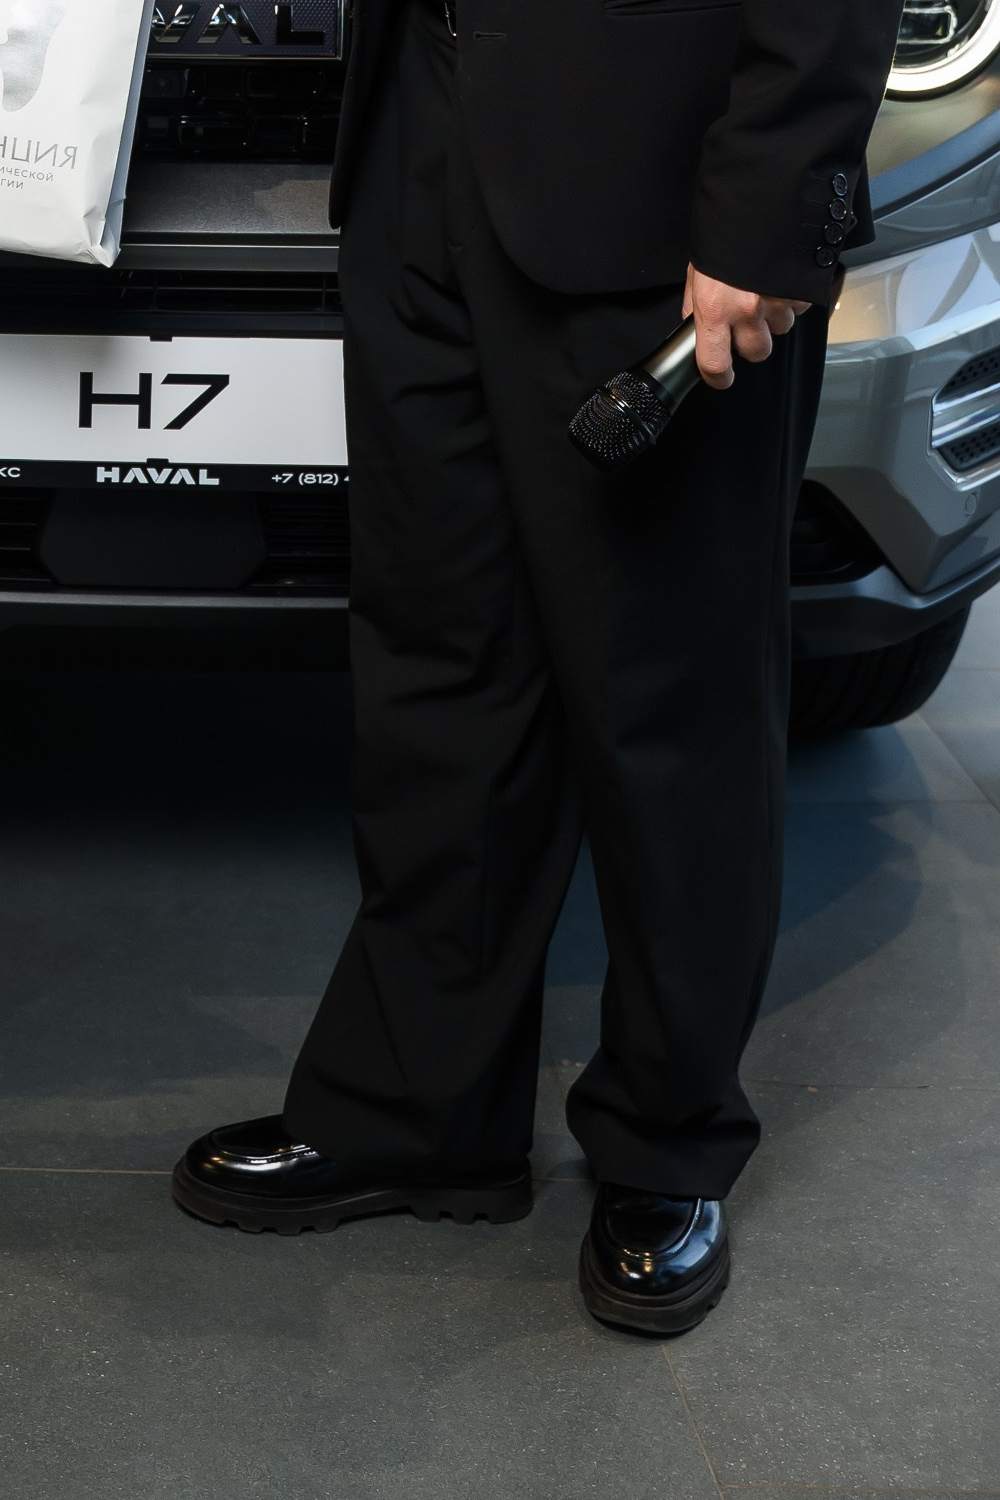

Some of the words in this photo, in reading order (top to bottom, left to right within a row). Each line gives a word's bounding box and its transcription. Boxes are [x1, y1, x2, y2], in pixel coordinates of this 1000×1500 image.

[150, 3, 326, 46] VAL
[78, 371, 231, 431] H7
[96, 466, 220, 486] HAVAL
[271, 473, 294, 484] +7
[298, 472, 339, 486] (812)
